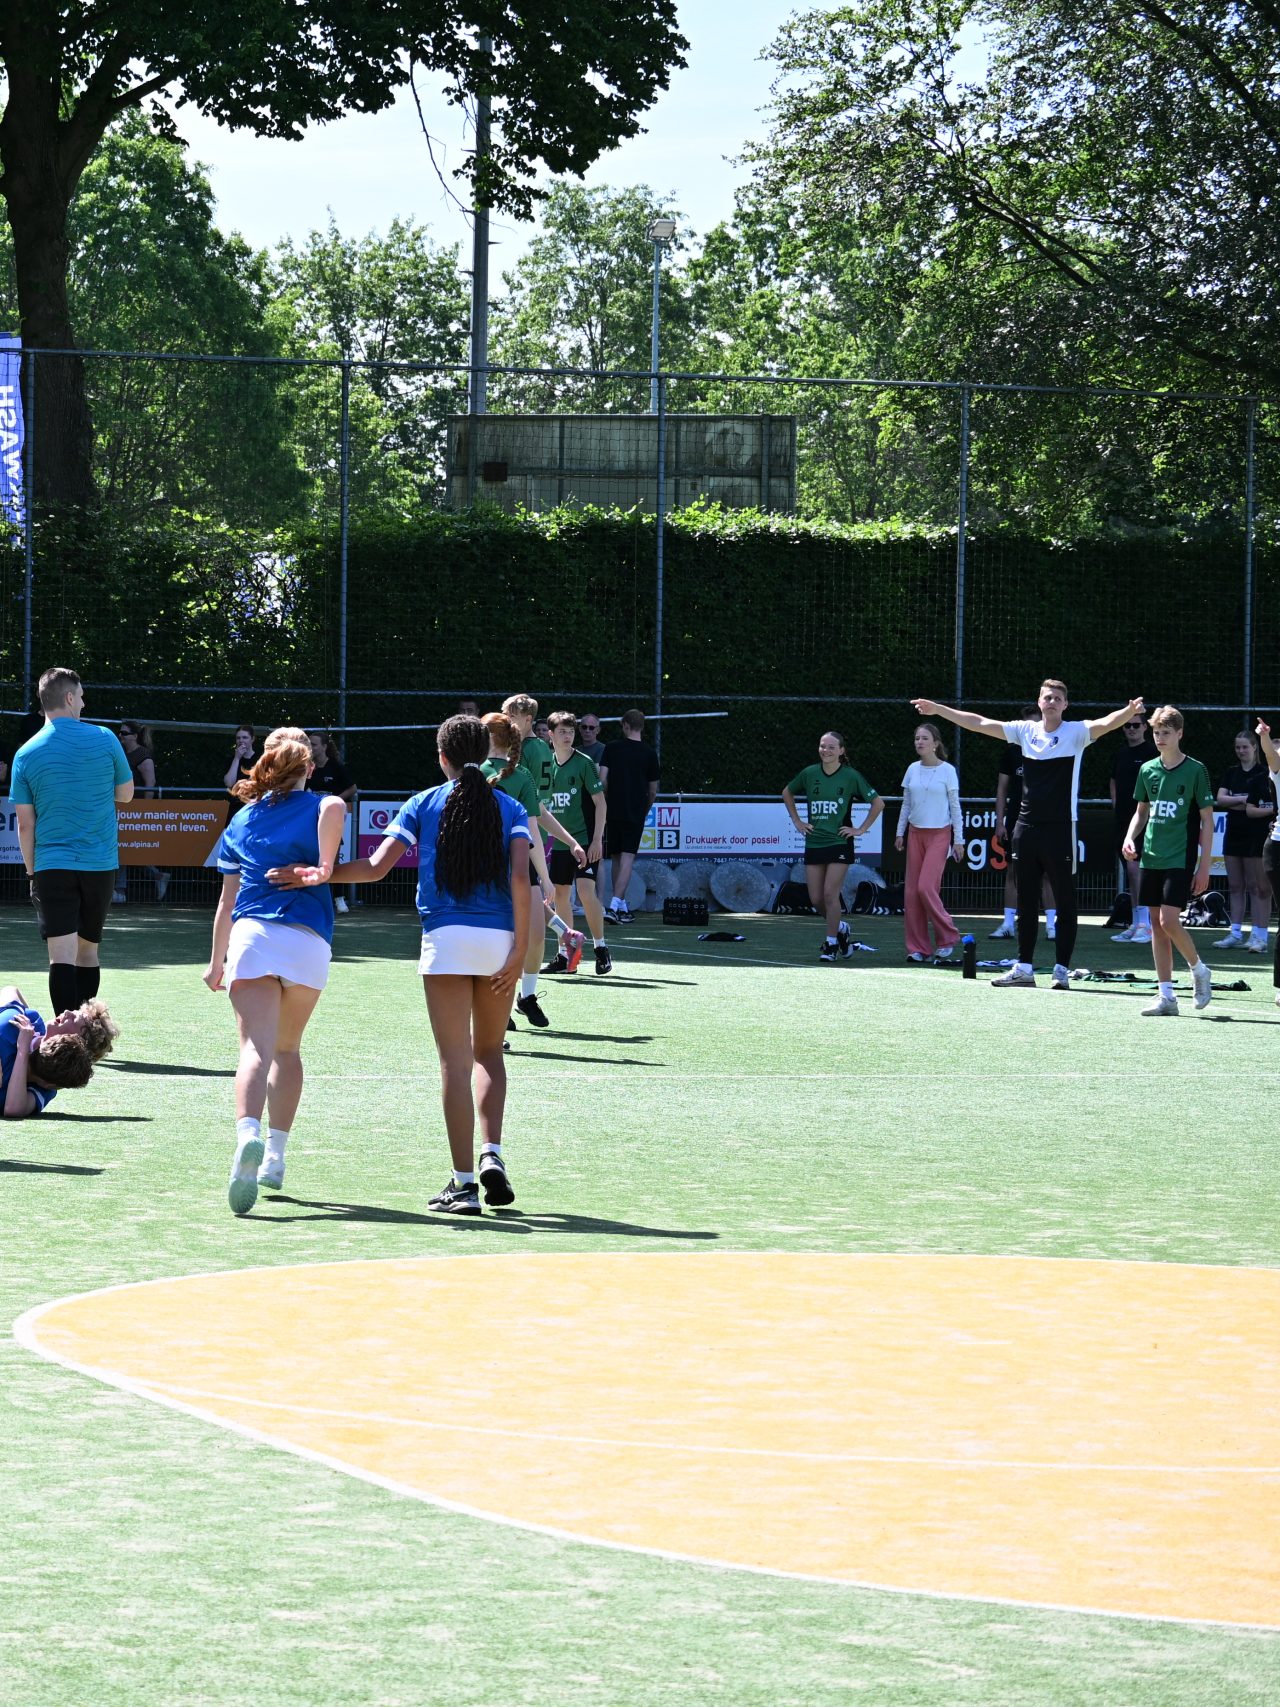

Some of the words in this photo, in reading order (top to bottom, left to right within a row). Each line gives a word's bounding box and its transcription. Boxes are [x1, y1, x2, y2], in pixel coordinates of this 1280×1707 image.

[539, 761, 552, 791] 5
[551, 792, 571, 807] TER
[811, 800, 838, 815] BTER
[117, 810, 142, 821] jouw
[144, 810, 180, 820] manier
[181, 813, 218, 823] wonen,
[117, 822, 162, 832] ernemen
[165, 824, 177, 832] en
[180, 823, 209, 833] leven.
[662, 830, 678, 848] B
[685, 835, 727, 845] Drukwerk
[730, 835, 749, 845] door
